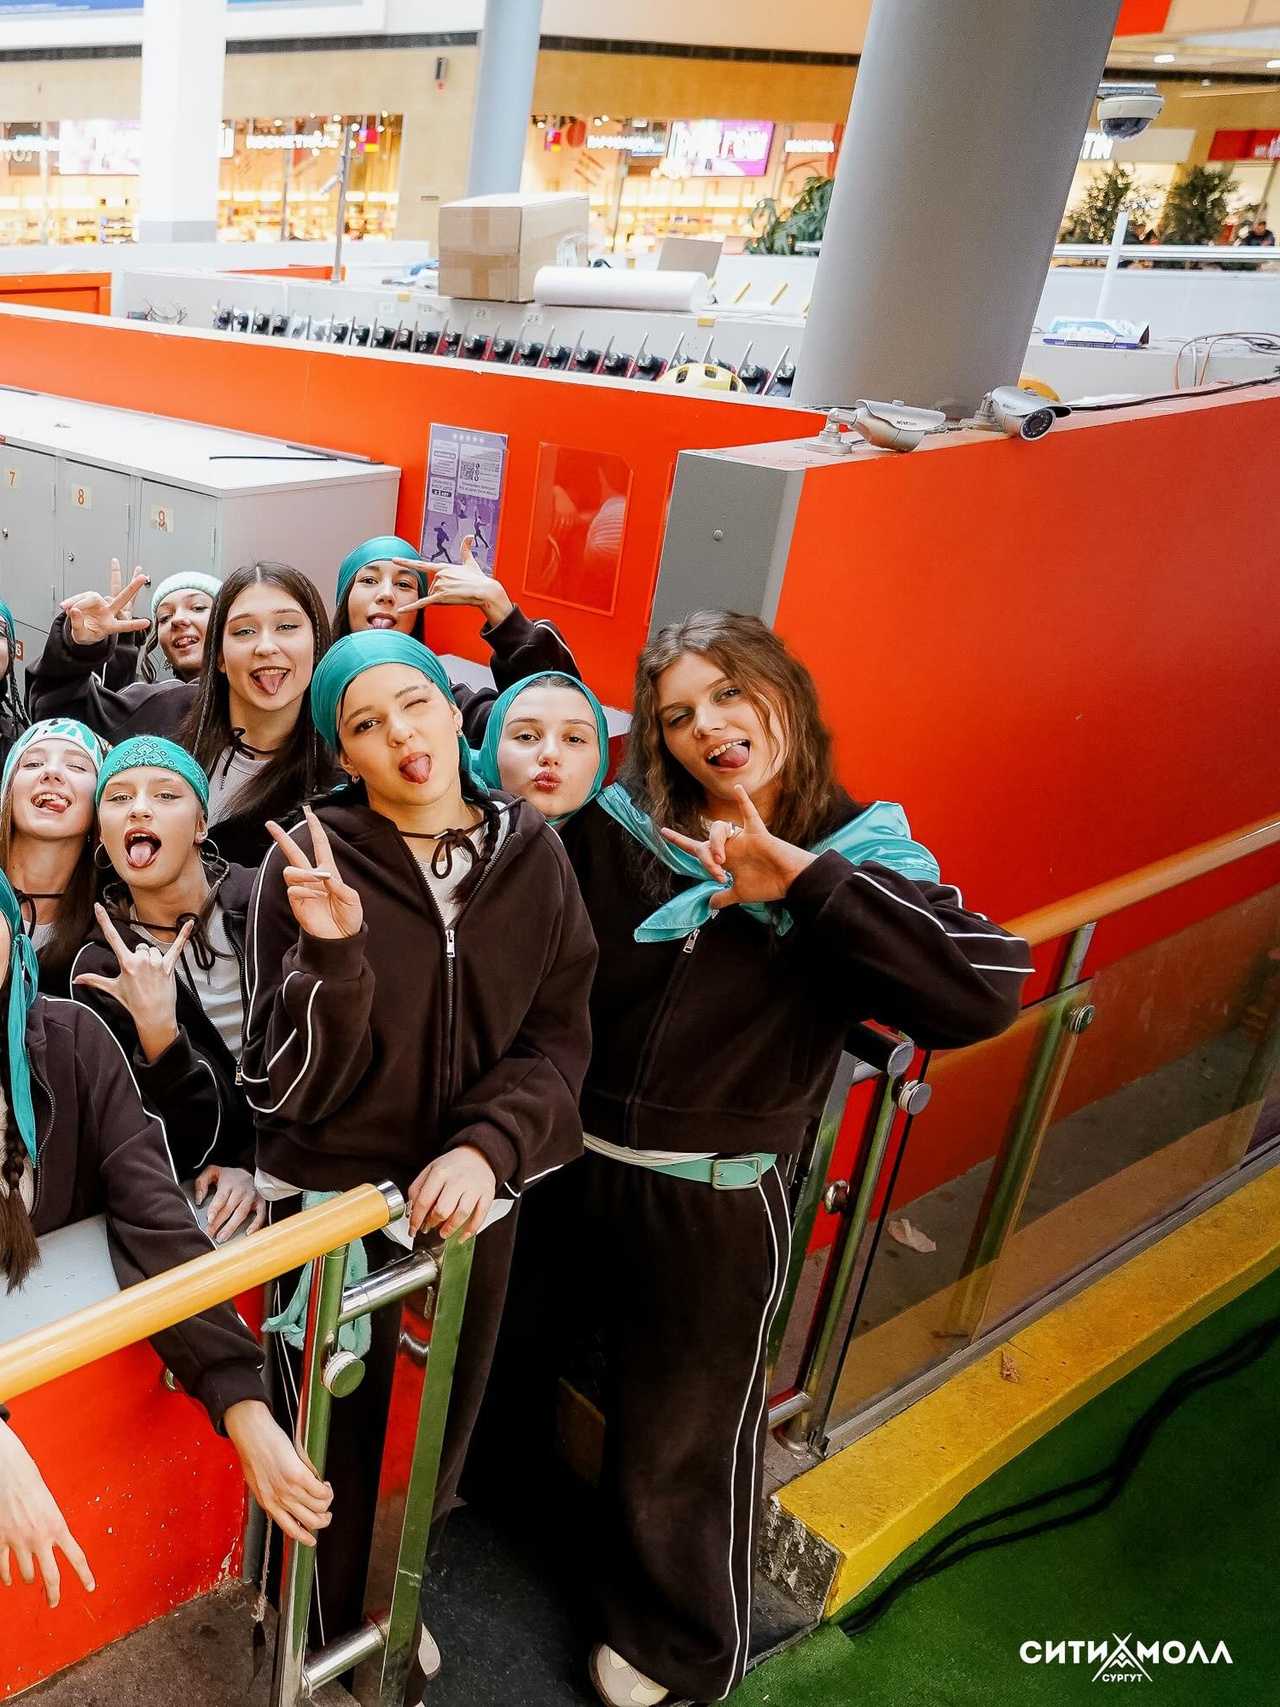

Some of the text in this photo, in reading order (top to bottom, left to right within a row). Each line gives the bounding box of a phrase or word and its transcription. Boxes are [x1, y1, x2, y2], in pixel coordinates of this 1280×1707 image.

[9, 471, 16, 486] 7
[78, 489, 85, 505] 8
[158, 509, 166, 528] 9
